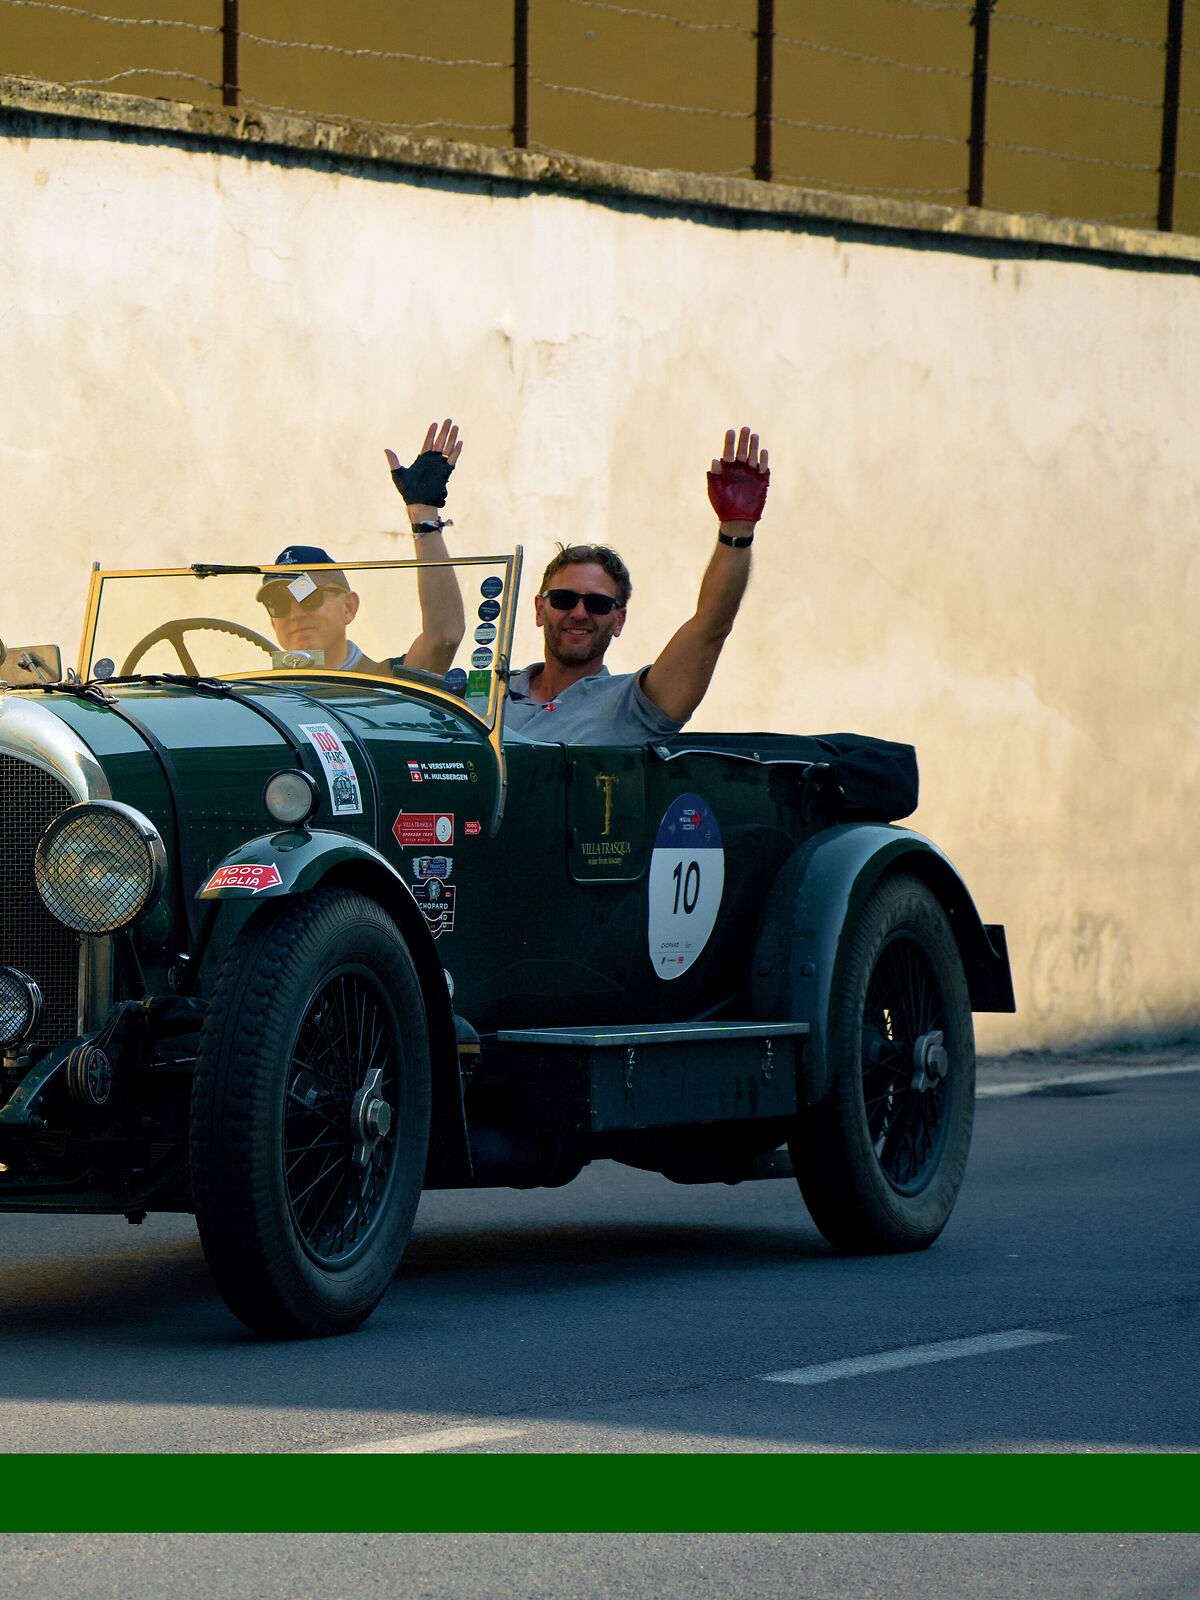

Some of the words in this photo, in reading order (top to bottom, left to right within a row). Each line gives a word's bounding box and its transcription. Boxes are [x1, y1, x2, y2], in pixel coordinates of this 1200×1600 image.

[311, 732, 340, 752] 100
[322, 751, 346, 764] YEARS
[428, 762, 465, 770] VERSTAPPEN
[441, 824, 447, 834] 3
[581, 843, 601, 855] VILLA
[601, 841, 631, 856] TRASQUA
[222, 867, 264, 876] 1000
[211, 876, 260, 887] MIGLIA
[672, 860, 701, 915] 10
